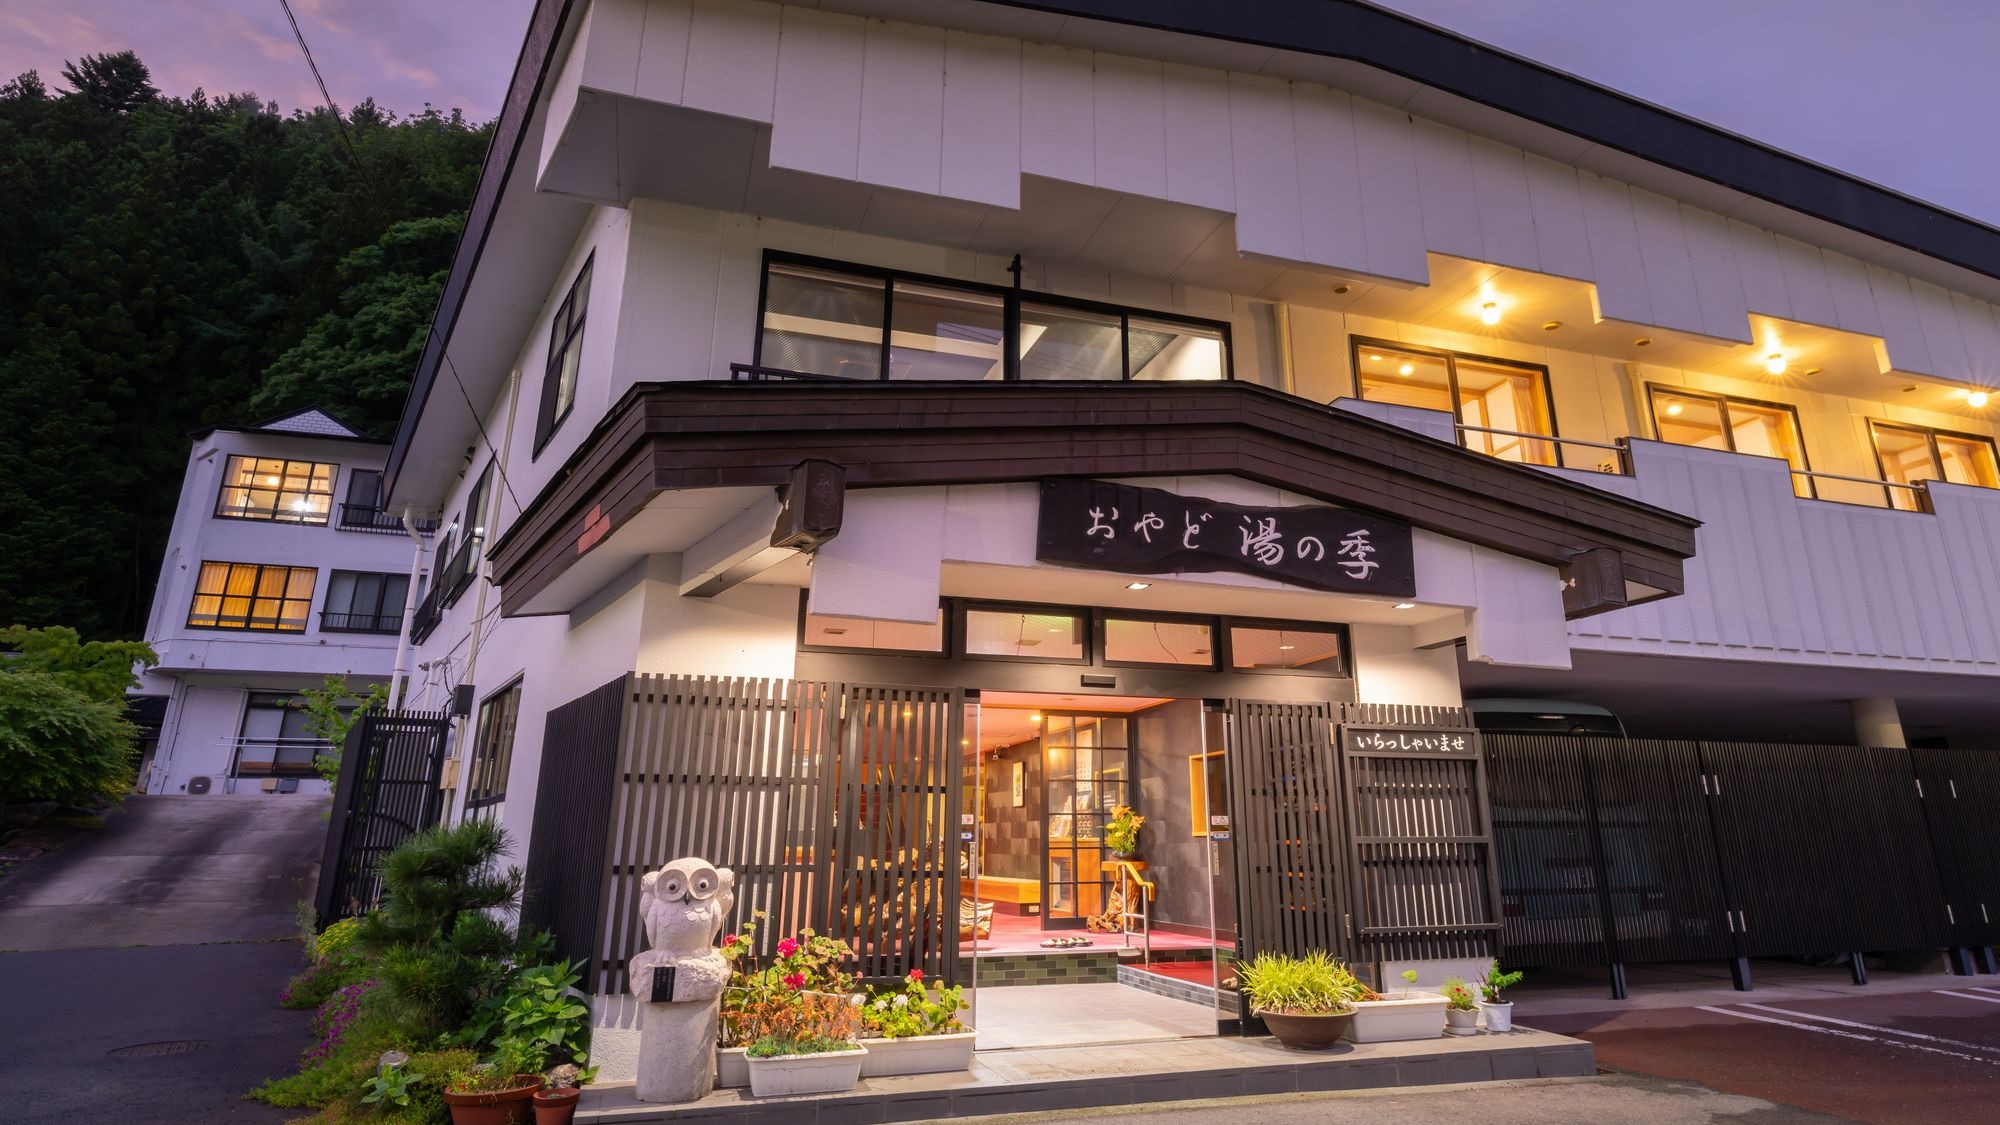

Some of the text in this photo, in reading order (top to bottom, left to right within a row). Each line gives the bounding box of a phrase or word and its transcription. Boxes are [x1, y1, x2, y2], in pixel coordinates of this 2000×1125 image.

[1356, 733, 1465, 752] いらっしゃいませ
